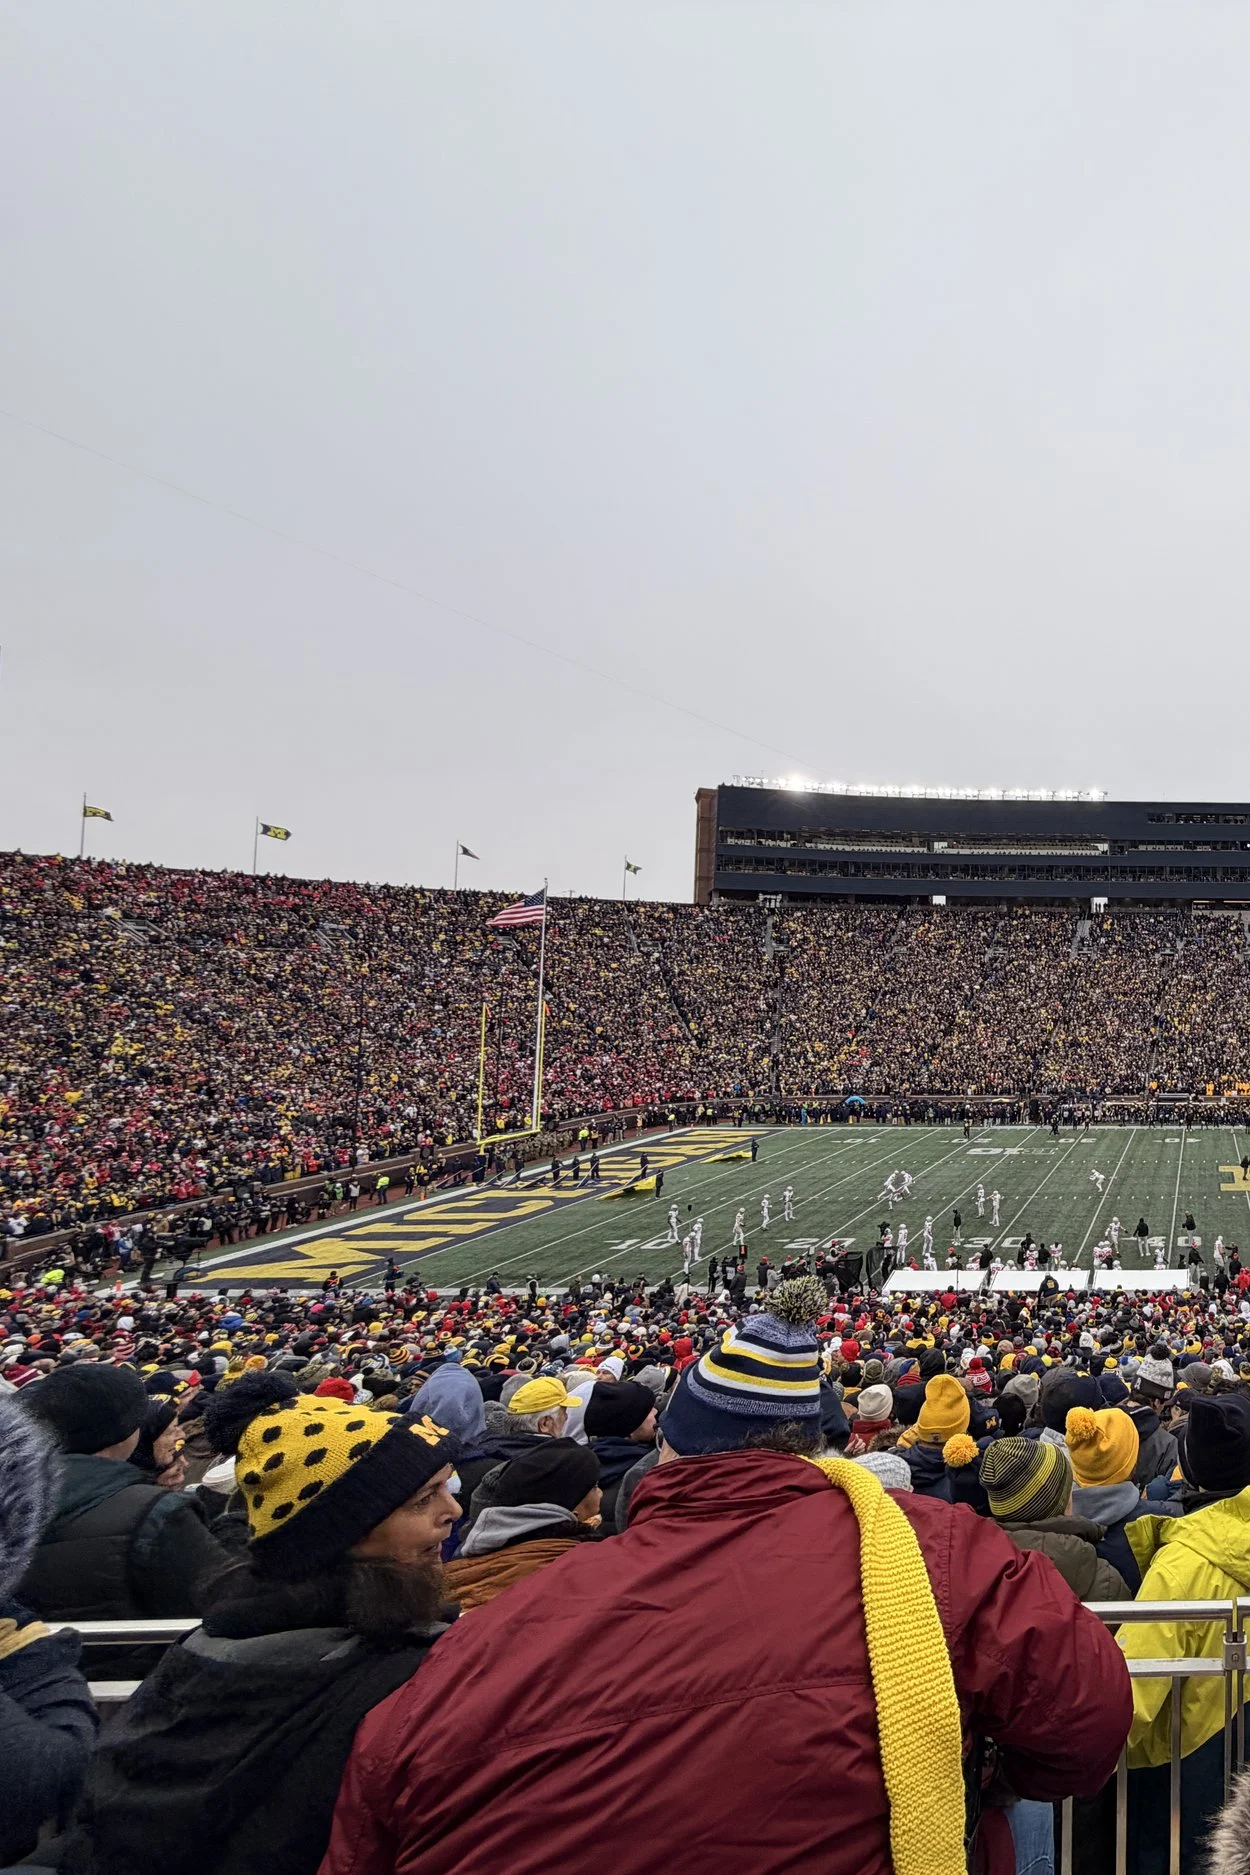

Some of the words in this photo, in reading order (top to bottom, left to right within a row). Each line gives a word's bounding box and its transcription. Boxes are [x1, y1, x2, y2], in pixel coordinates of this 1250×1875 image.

[609, 1239, 676, 1250] 10
[784, 1238, 856, 1250] 20
[964, 1237, 1026, 1249] 30
[409, 1414, 450, 1447] M
